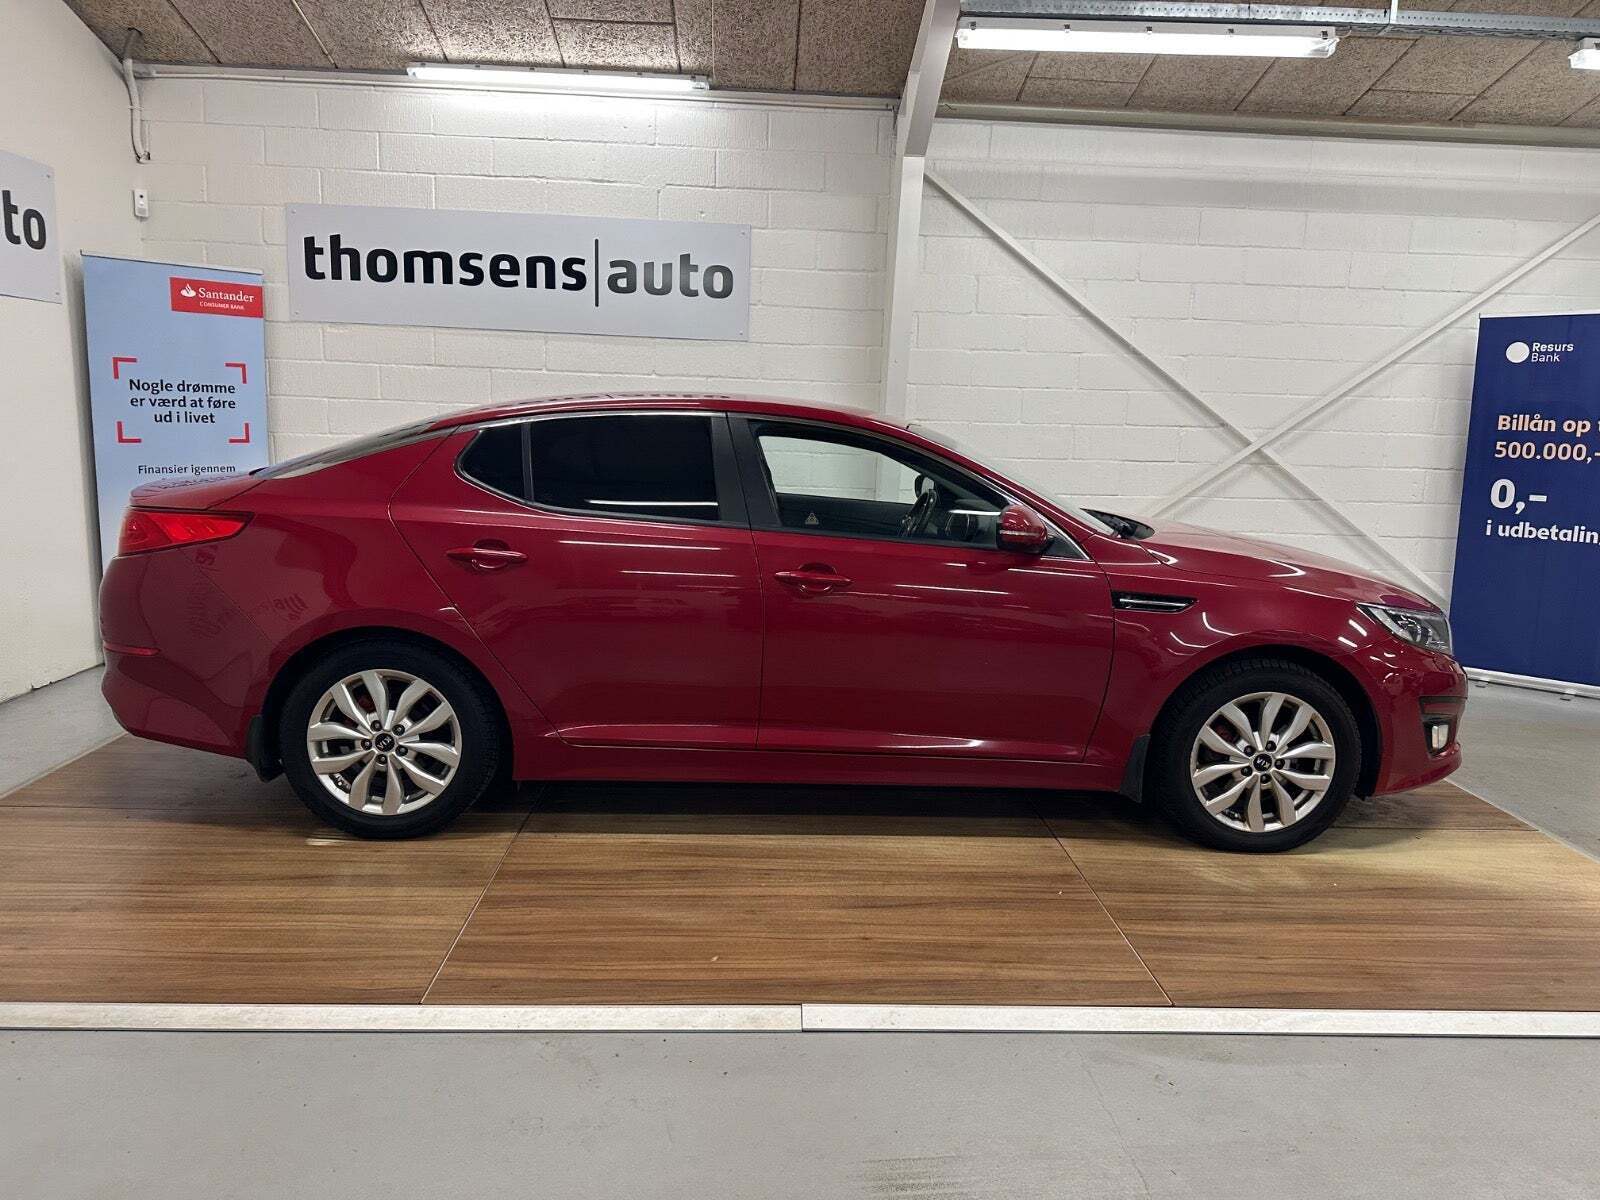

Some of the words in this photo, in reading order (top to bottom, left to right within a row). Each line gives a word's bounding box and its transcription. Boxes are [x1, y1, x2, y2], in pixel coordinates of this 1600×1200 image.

[199, 287, 255, 302] Santander
[200, 301, 229, 309] CONSUMER
[1532, 342, 1574, 352] Resurs
[1531, 352, 1561, 363] Bank
[129, 379, 173, 395] Nogle
[177, 380, 236, 394] drømme
[130, 398, 146, 407] er
[149, 396, 187, 408] værd
[190, 398, 205, 408] at
[207, 398, 236, 409] føre
[154, 411, 172, 423] ud
[176, 411, 181, 423] i
[184, 411, 216, 424] livet
[1497, 414, 1556, 432] Billån
[1562, 420, 1591, 437] op
[138, 464, 188, 474] Finansier
[191, 464, 236, 475] igennem
[1486, 519, 1492, 536] i
[1498, 521, 1600, 546] udbetalin
